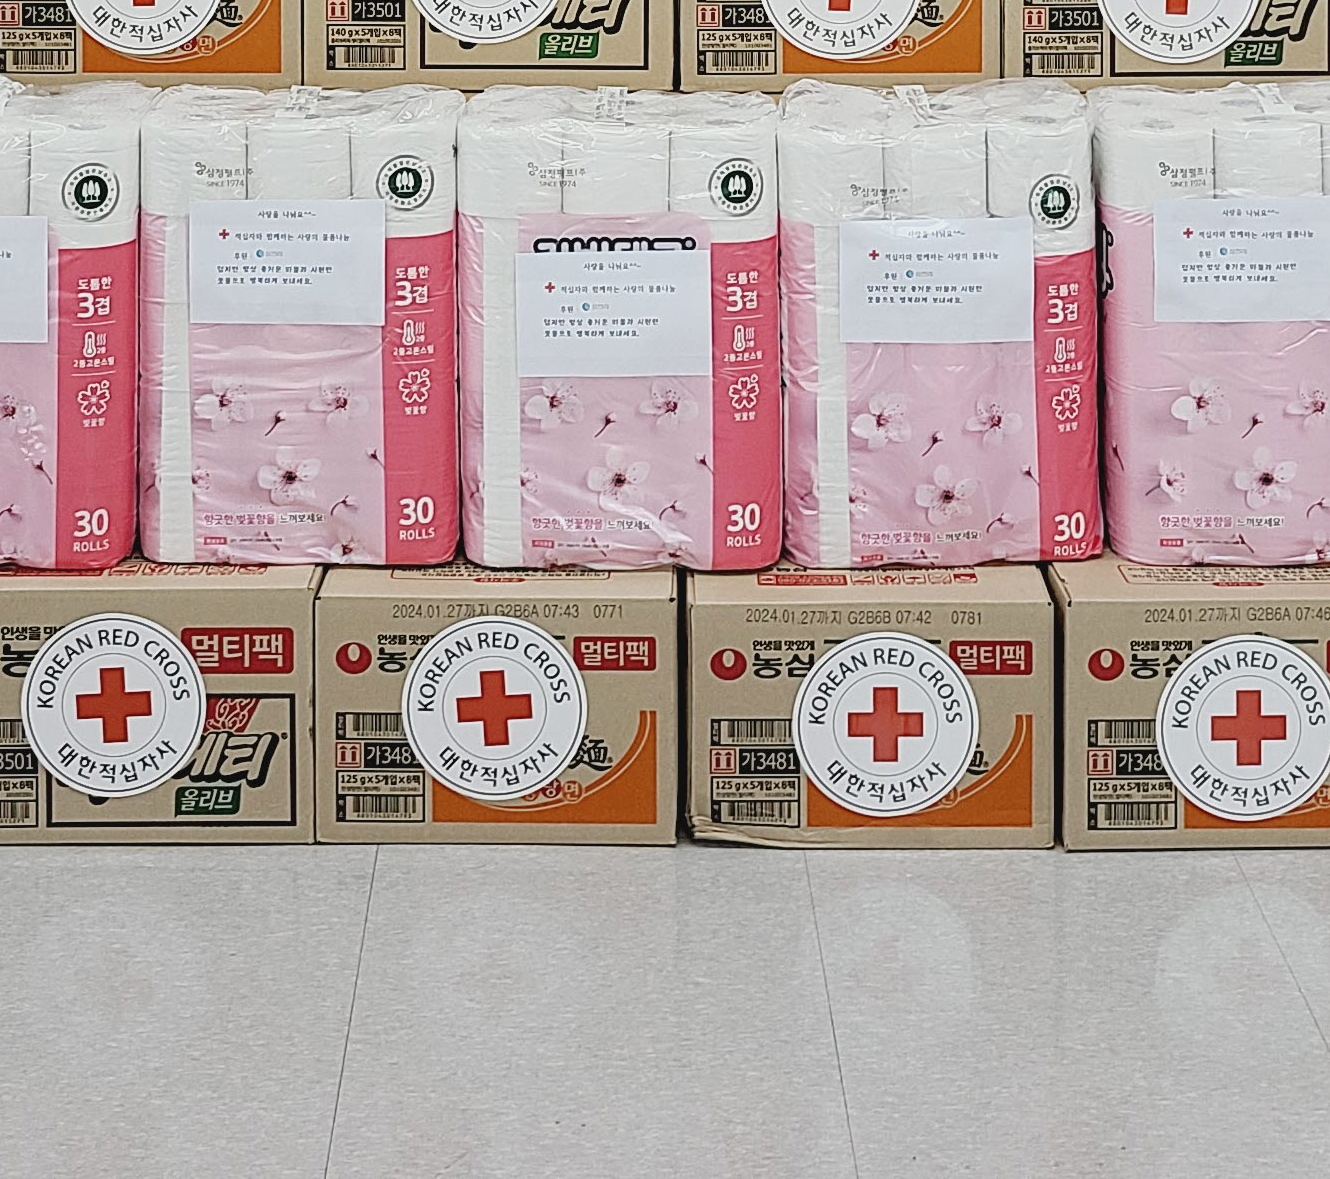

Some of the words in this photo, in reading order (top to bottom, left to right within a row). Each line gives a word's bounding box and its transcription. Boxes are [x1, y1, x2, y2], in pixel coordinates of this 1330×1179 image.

[92, 4, 199, 43] 대한적십자사
[354, 1, 402, 19] 가3501
[1124, 11, 1231, 52] 대한적십자사
[398, 496, 434, 526] 30
[726, 502, 761, 532] 30
[399, 526, 435, 541] ROLLS
[726, 533, 762, 548] ROLLS
[544, 604, 579, 618] 07:43
[593, 604, 623, 618] 0771
[896, 611, 932, 624] 07:42
[951, 611, 982, 624] 0781
[191, 633, 283, 668] 멀티팩
[580, 640, 649, 667] 멀티팩
[808, 651, 869, 725] KOREAN
[873, 647, 915, 668] RED
[918, 661, 963, 724] CROSS
[826, 759, 947, 804] 대한적십자사
[179, 787, 234, 811] 올리브
